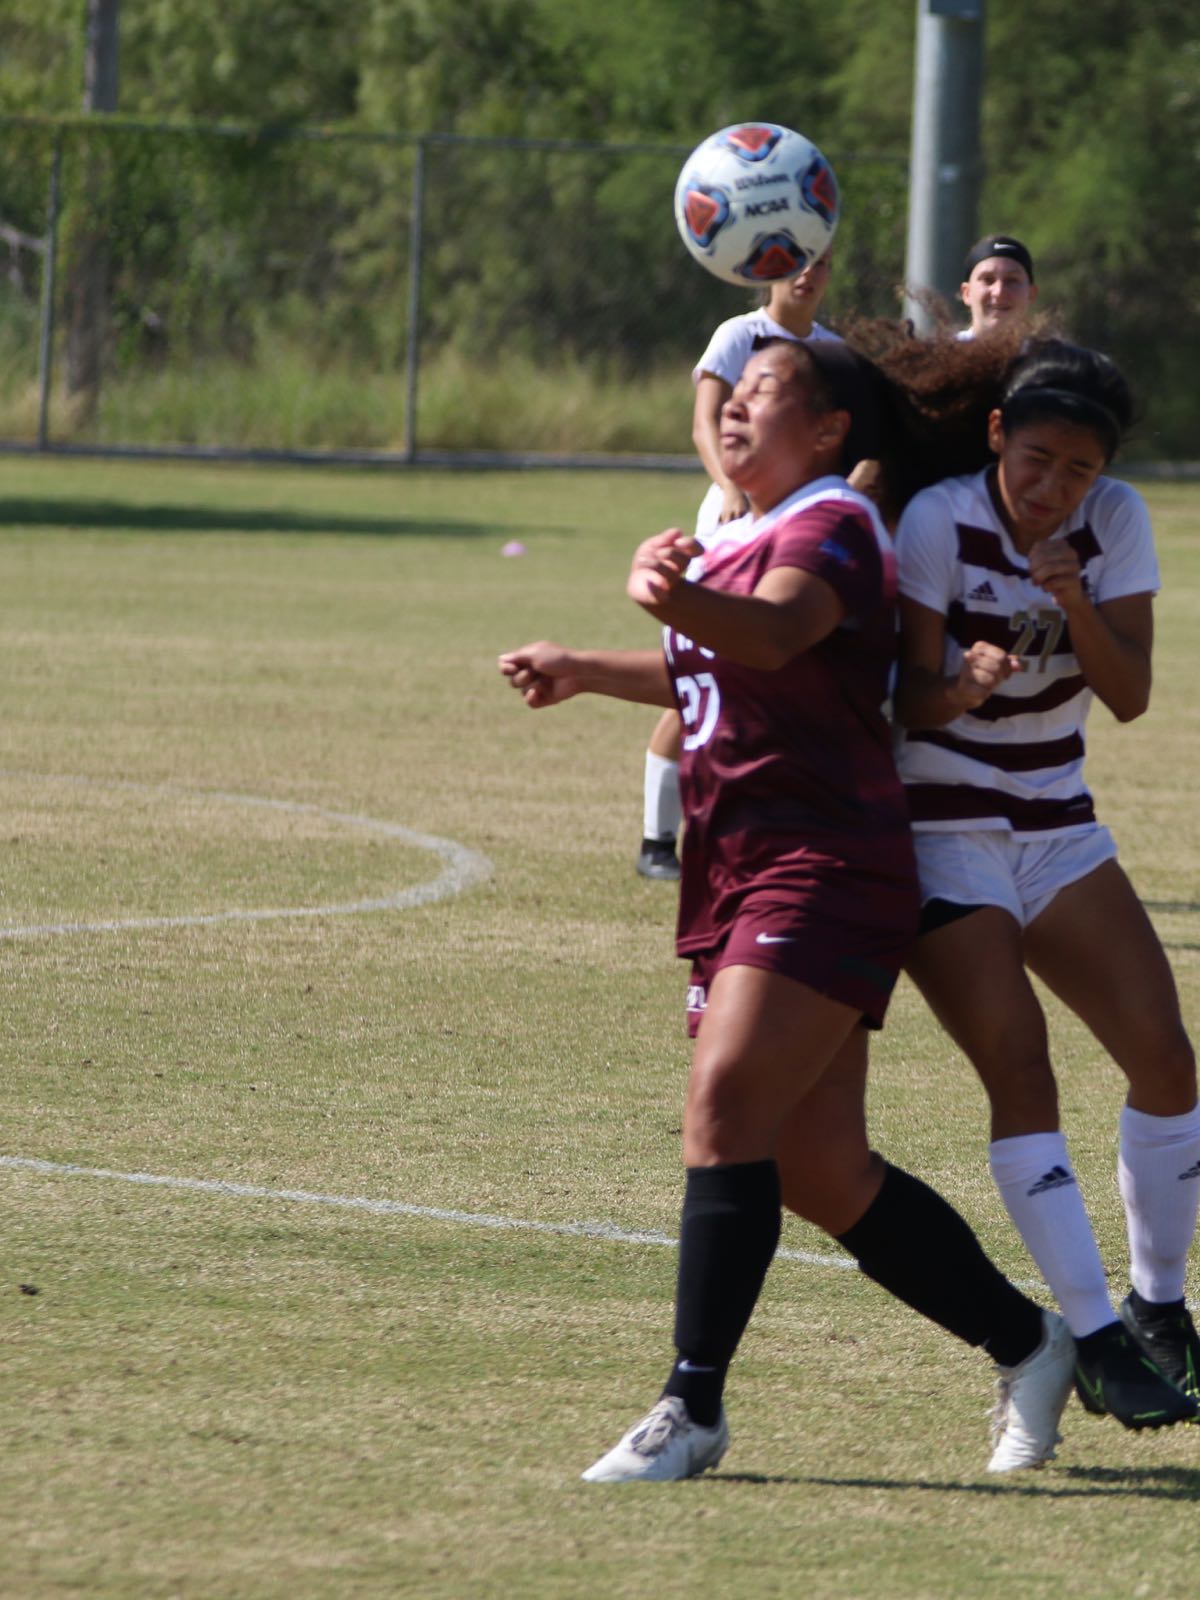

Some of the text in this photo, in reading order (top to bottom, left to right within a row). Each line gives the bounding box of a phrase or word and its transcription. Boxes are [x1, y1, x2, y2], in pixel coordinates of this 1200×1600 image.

[735, 173, 789, 190] Wilson
[744, 196, 789, 217] NCAA
[1009, 609, 1063, 673] 27
